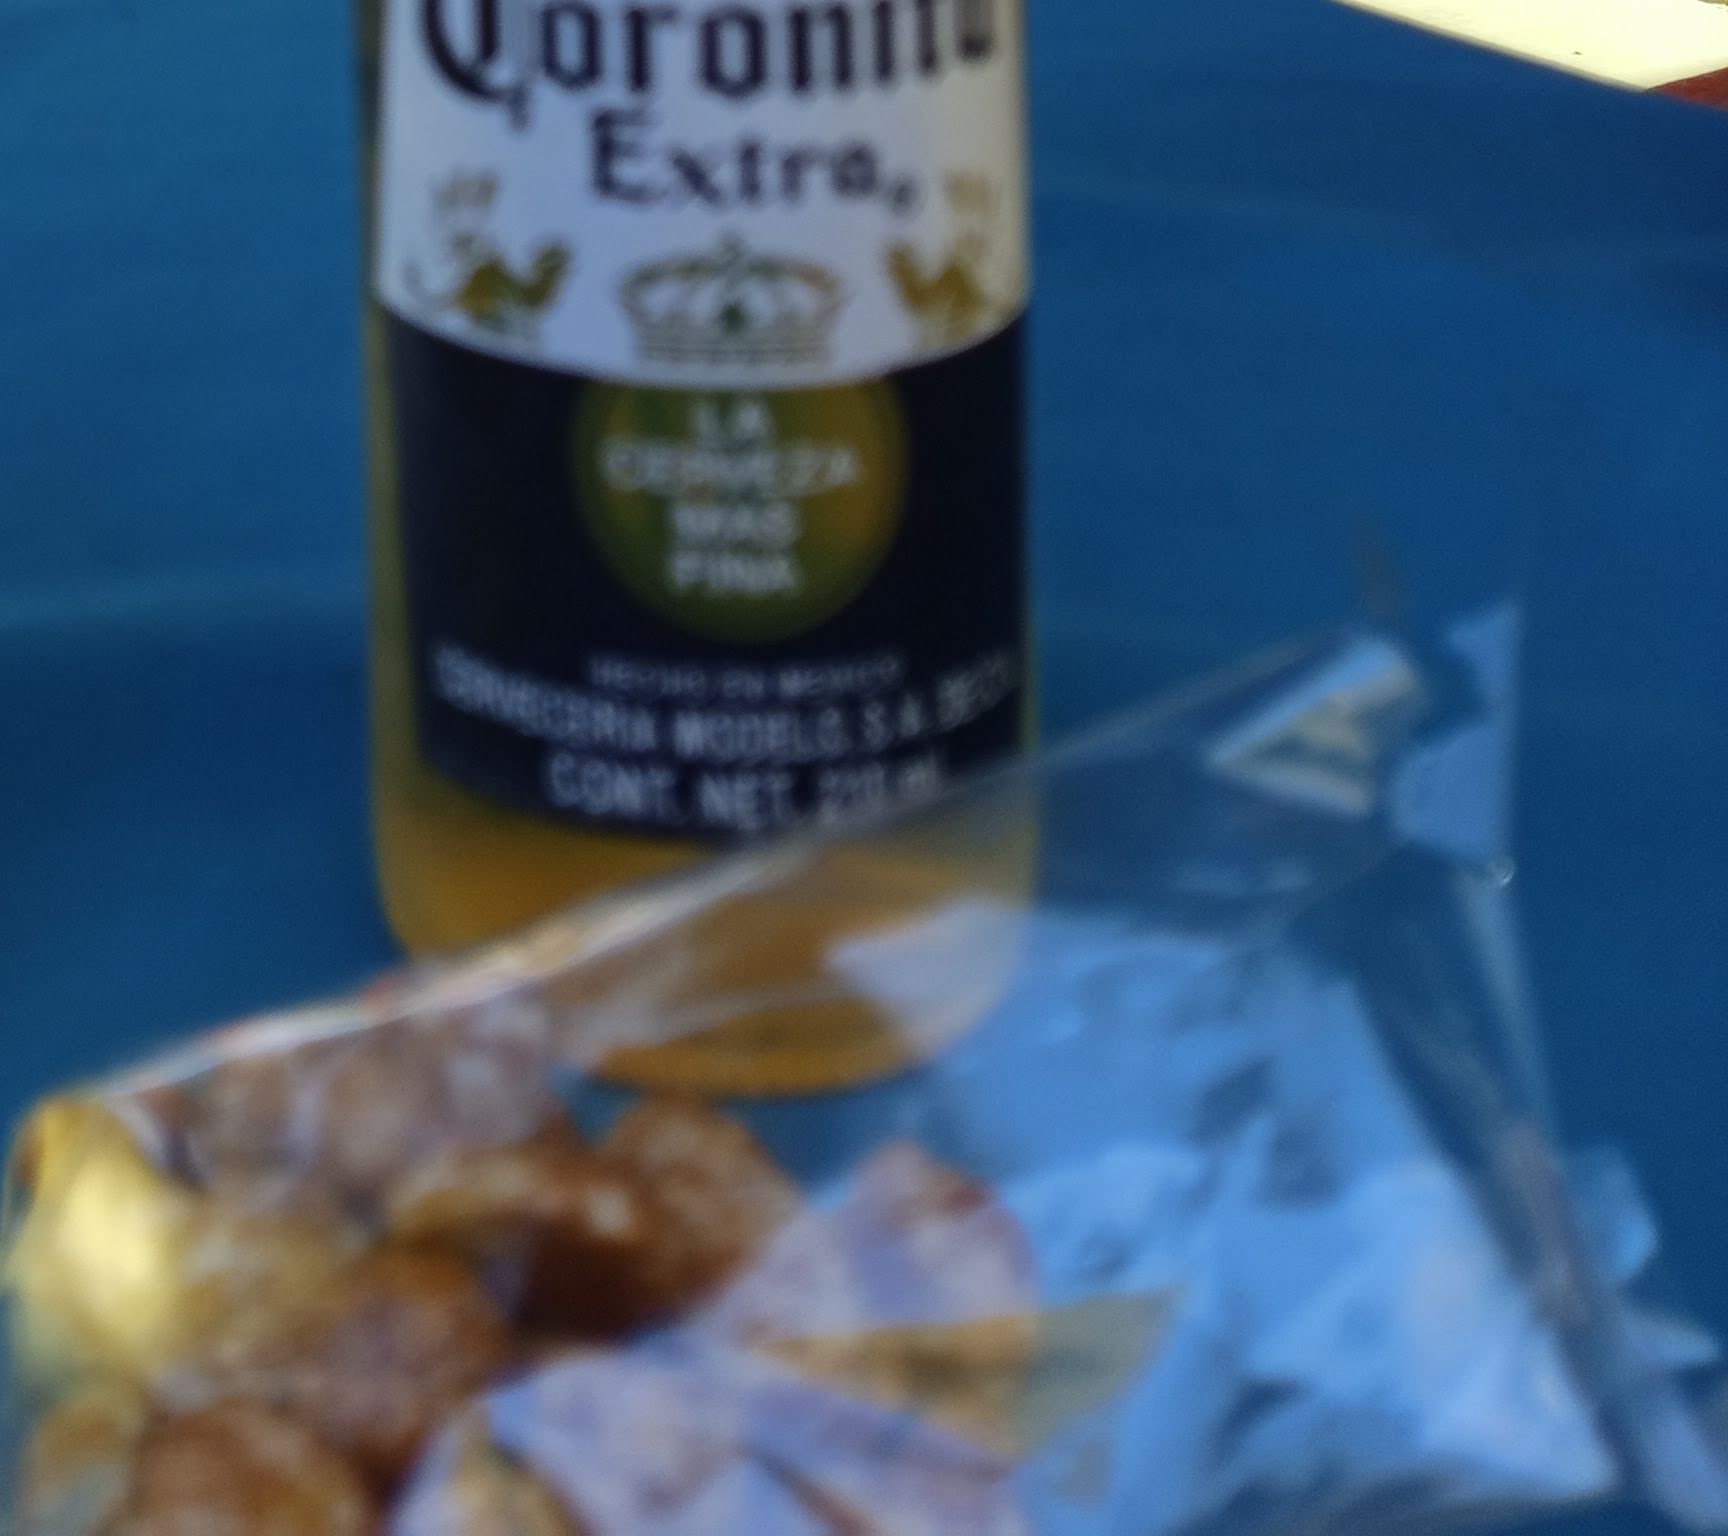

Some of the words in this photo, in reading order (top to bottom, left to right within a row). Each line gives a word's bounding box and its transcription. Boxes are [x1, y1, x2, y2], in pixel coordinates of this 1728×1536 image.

[590, 106, 880, 208] Extra
[688, 400, 774, 446] LA
[600, 438, 860, 496] CERVEZA
[668, 548, 802, 596] FINA
